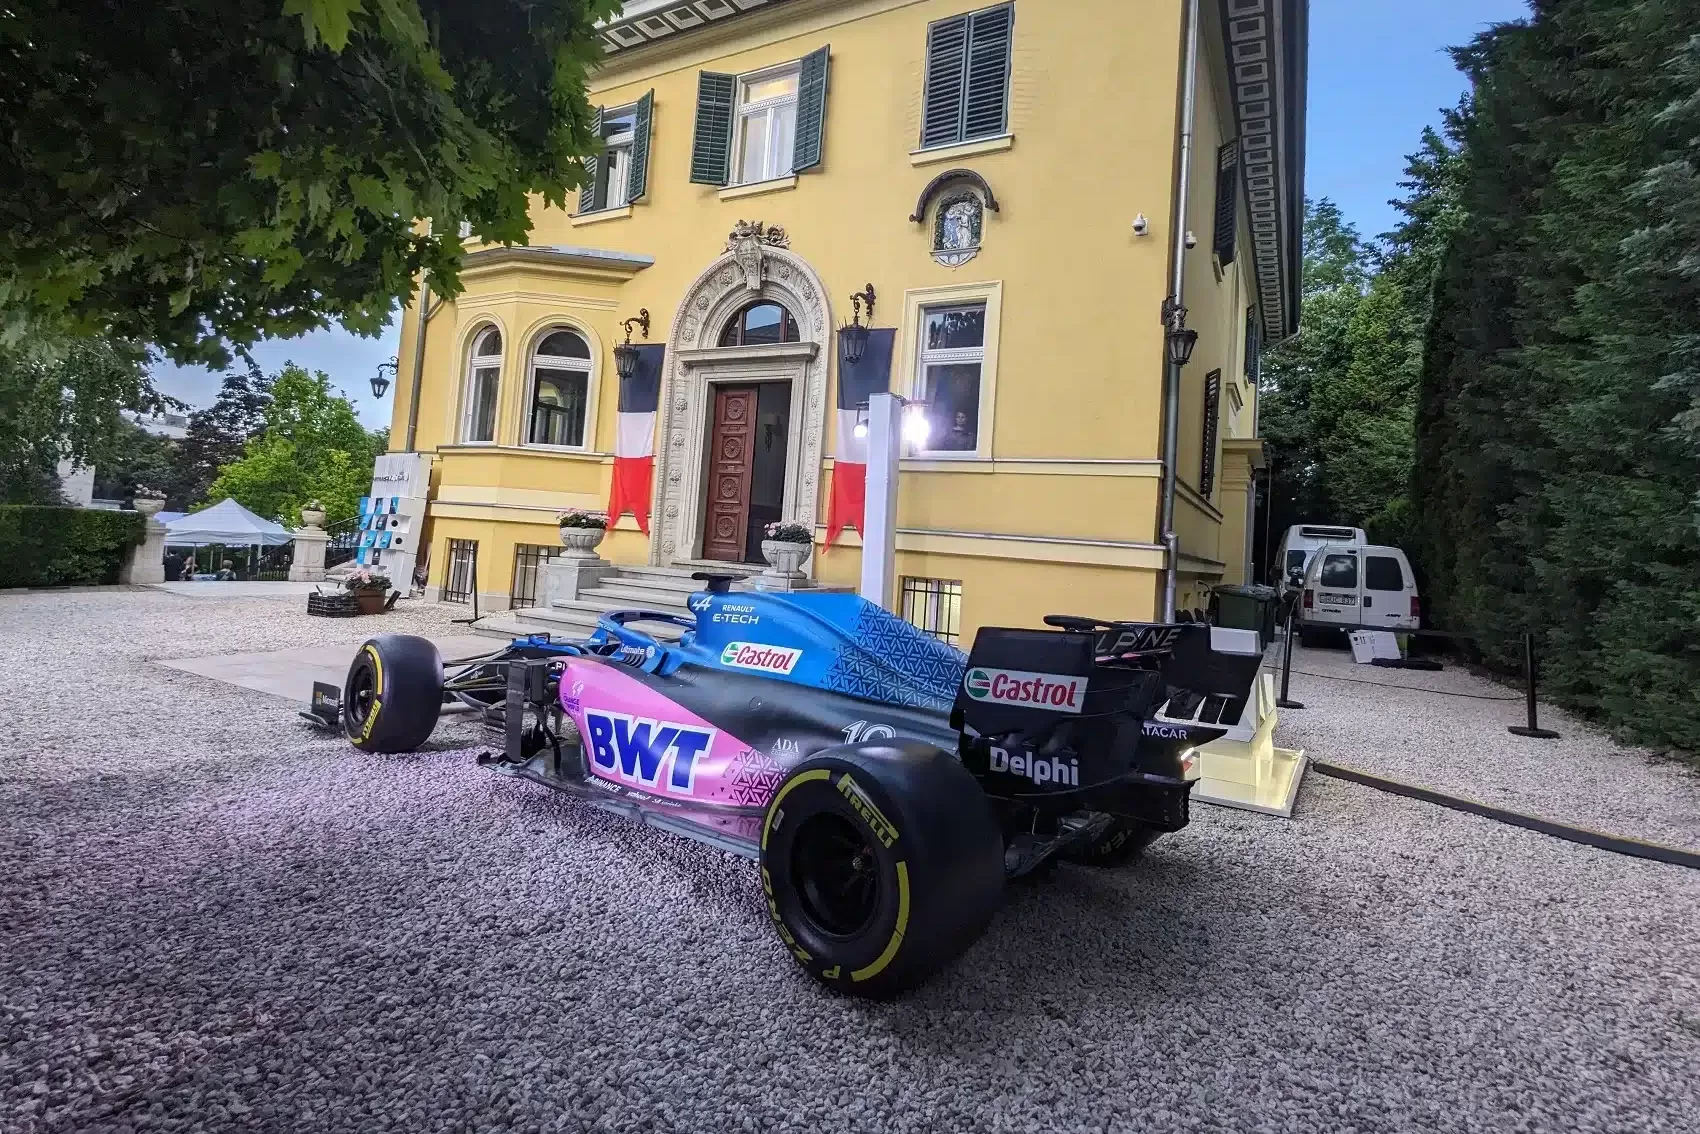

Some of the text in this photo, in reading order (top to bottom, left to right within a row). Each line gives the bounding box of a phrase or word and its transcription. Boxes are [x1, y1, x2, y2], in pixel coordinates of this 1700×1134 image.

[713, 614, 760, 625] E-TECH
[722, 604, 755, 613] RENAULT
[1095, 628, 1182, 653] LPINE
[735, 645, 795, 671] Castrol
[991, 674, 1077, 708] Castrol
[585, 710, 714, 791] BWT
[772, 738, 800, 753] ADA
[989, 746, 1079, 786] Delphi
[836, 772, 900, 849] PIRELLI
[761, 866, 841, 980] P ZERO
